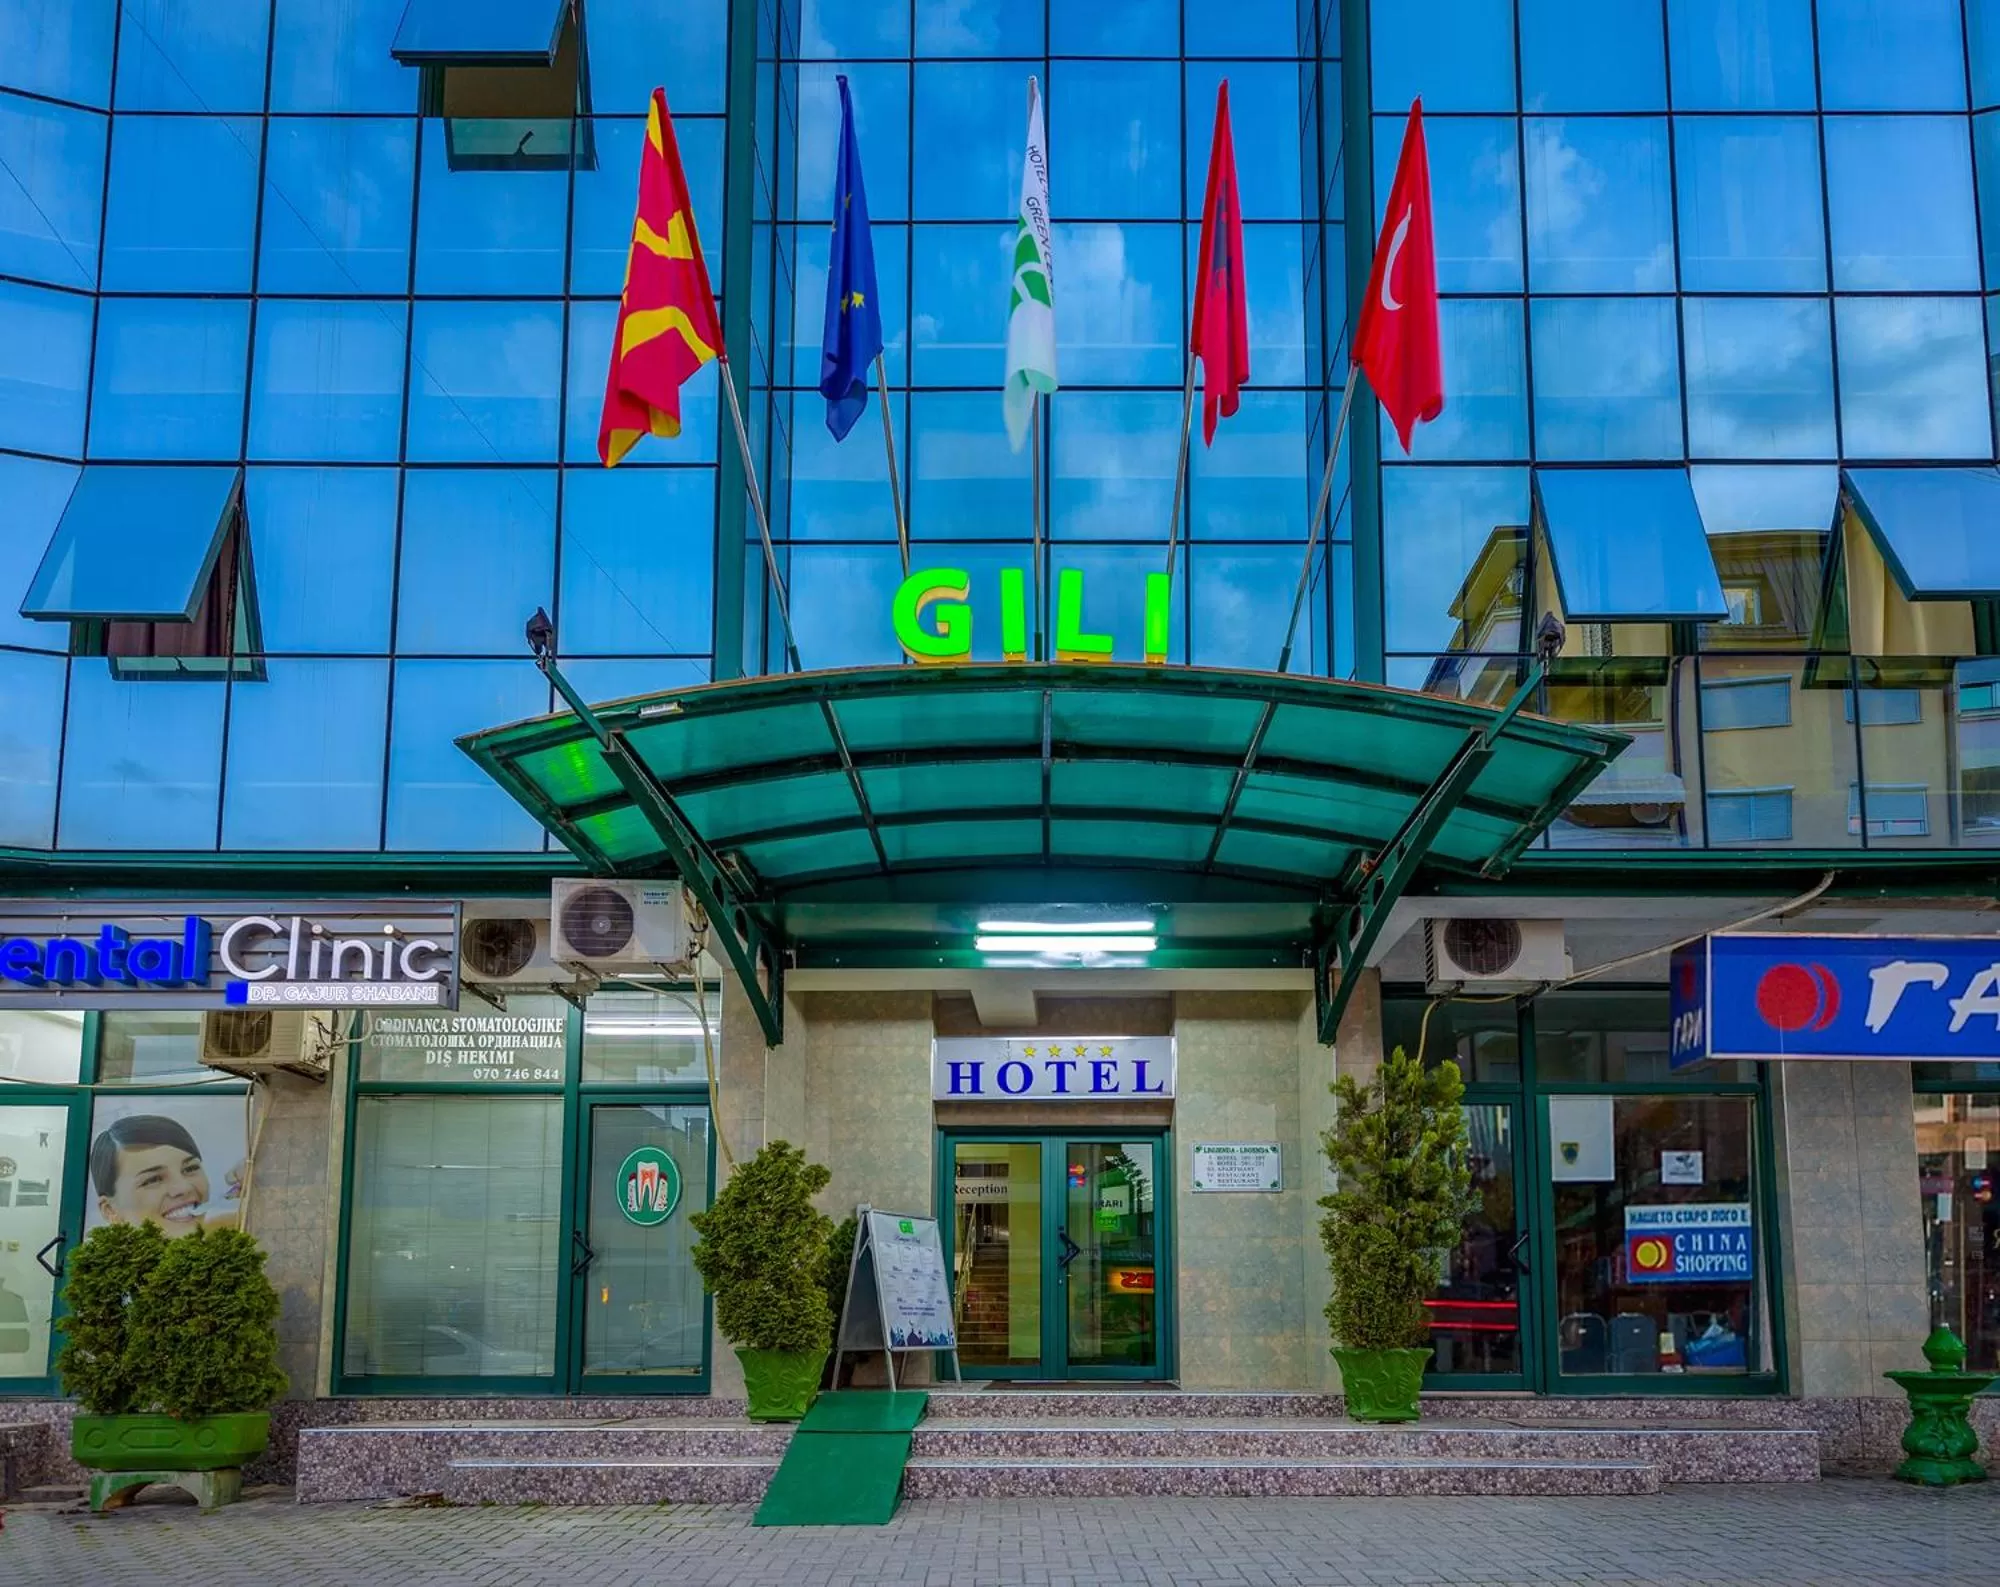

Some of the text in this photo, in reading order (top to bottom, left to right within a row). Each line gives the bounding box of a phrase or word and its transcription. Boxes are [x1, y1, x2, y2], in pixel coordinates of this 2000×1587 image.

[1029, 145, 1047, 183] HOTEL
[1026, 196, 1050, 249] GREEN
[892, 567, 1170, 660] GILI
[0, 914, 439, 981] ental Clinic
[250, 985, 439, 1001] DR. GAJUR SHABANI
[374, 1017, 448, 1033] ORDINANCA
[370, 1034, 562, 1050] СТОМАТОЛОШКА ОРДИНАЦИЈА
[457, 1051, 514, 1065] HEKIMI
[473, 1068, 560, 1080] 070 746 844
[946, 1059, 1165, 1095] HOTEL
[954, 1183, 1008, 1197] Reception
[1675, 1233, 1747, 1252] CHINA
[1675, 1253, 1748, 1273] SHOPPING
